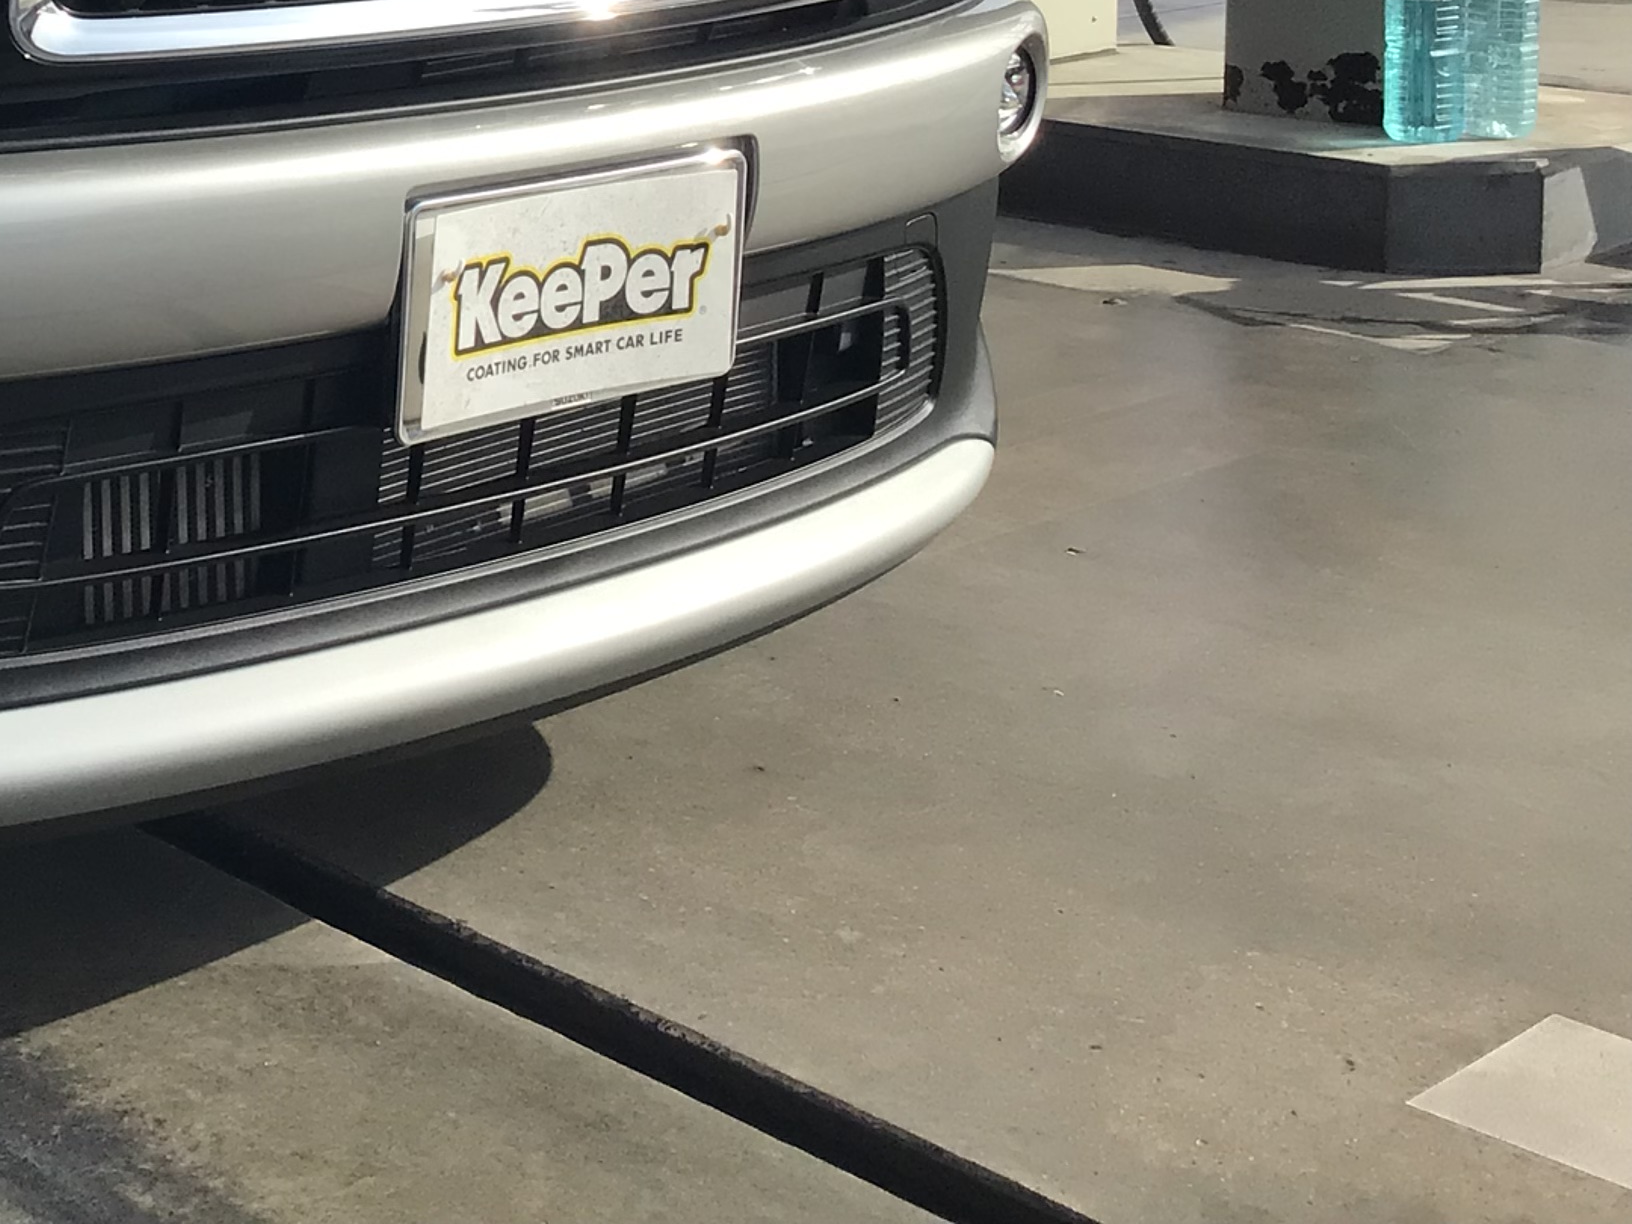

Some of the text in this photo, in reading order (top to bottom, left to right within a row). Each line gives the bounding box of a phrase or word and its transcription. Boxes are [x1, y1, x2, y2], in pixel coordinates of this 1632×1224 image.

[454, 237, 709, 355] KeePer
[466, 328, 683, 382] COATING FOR SMART CAR LIFE
